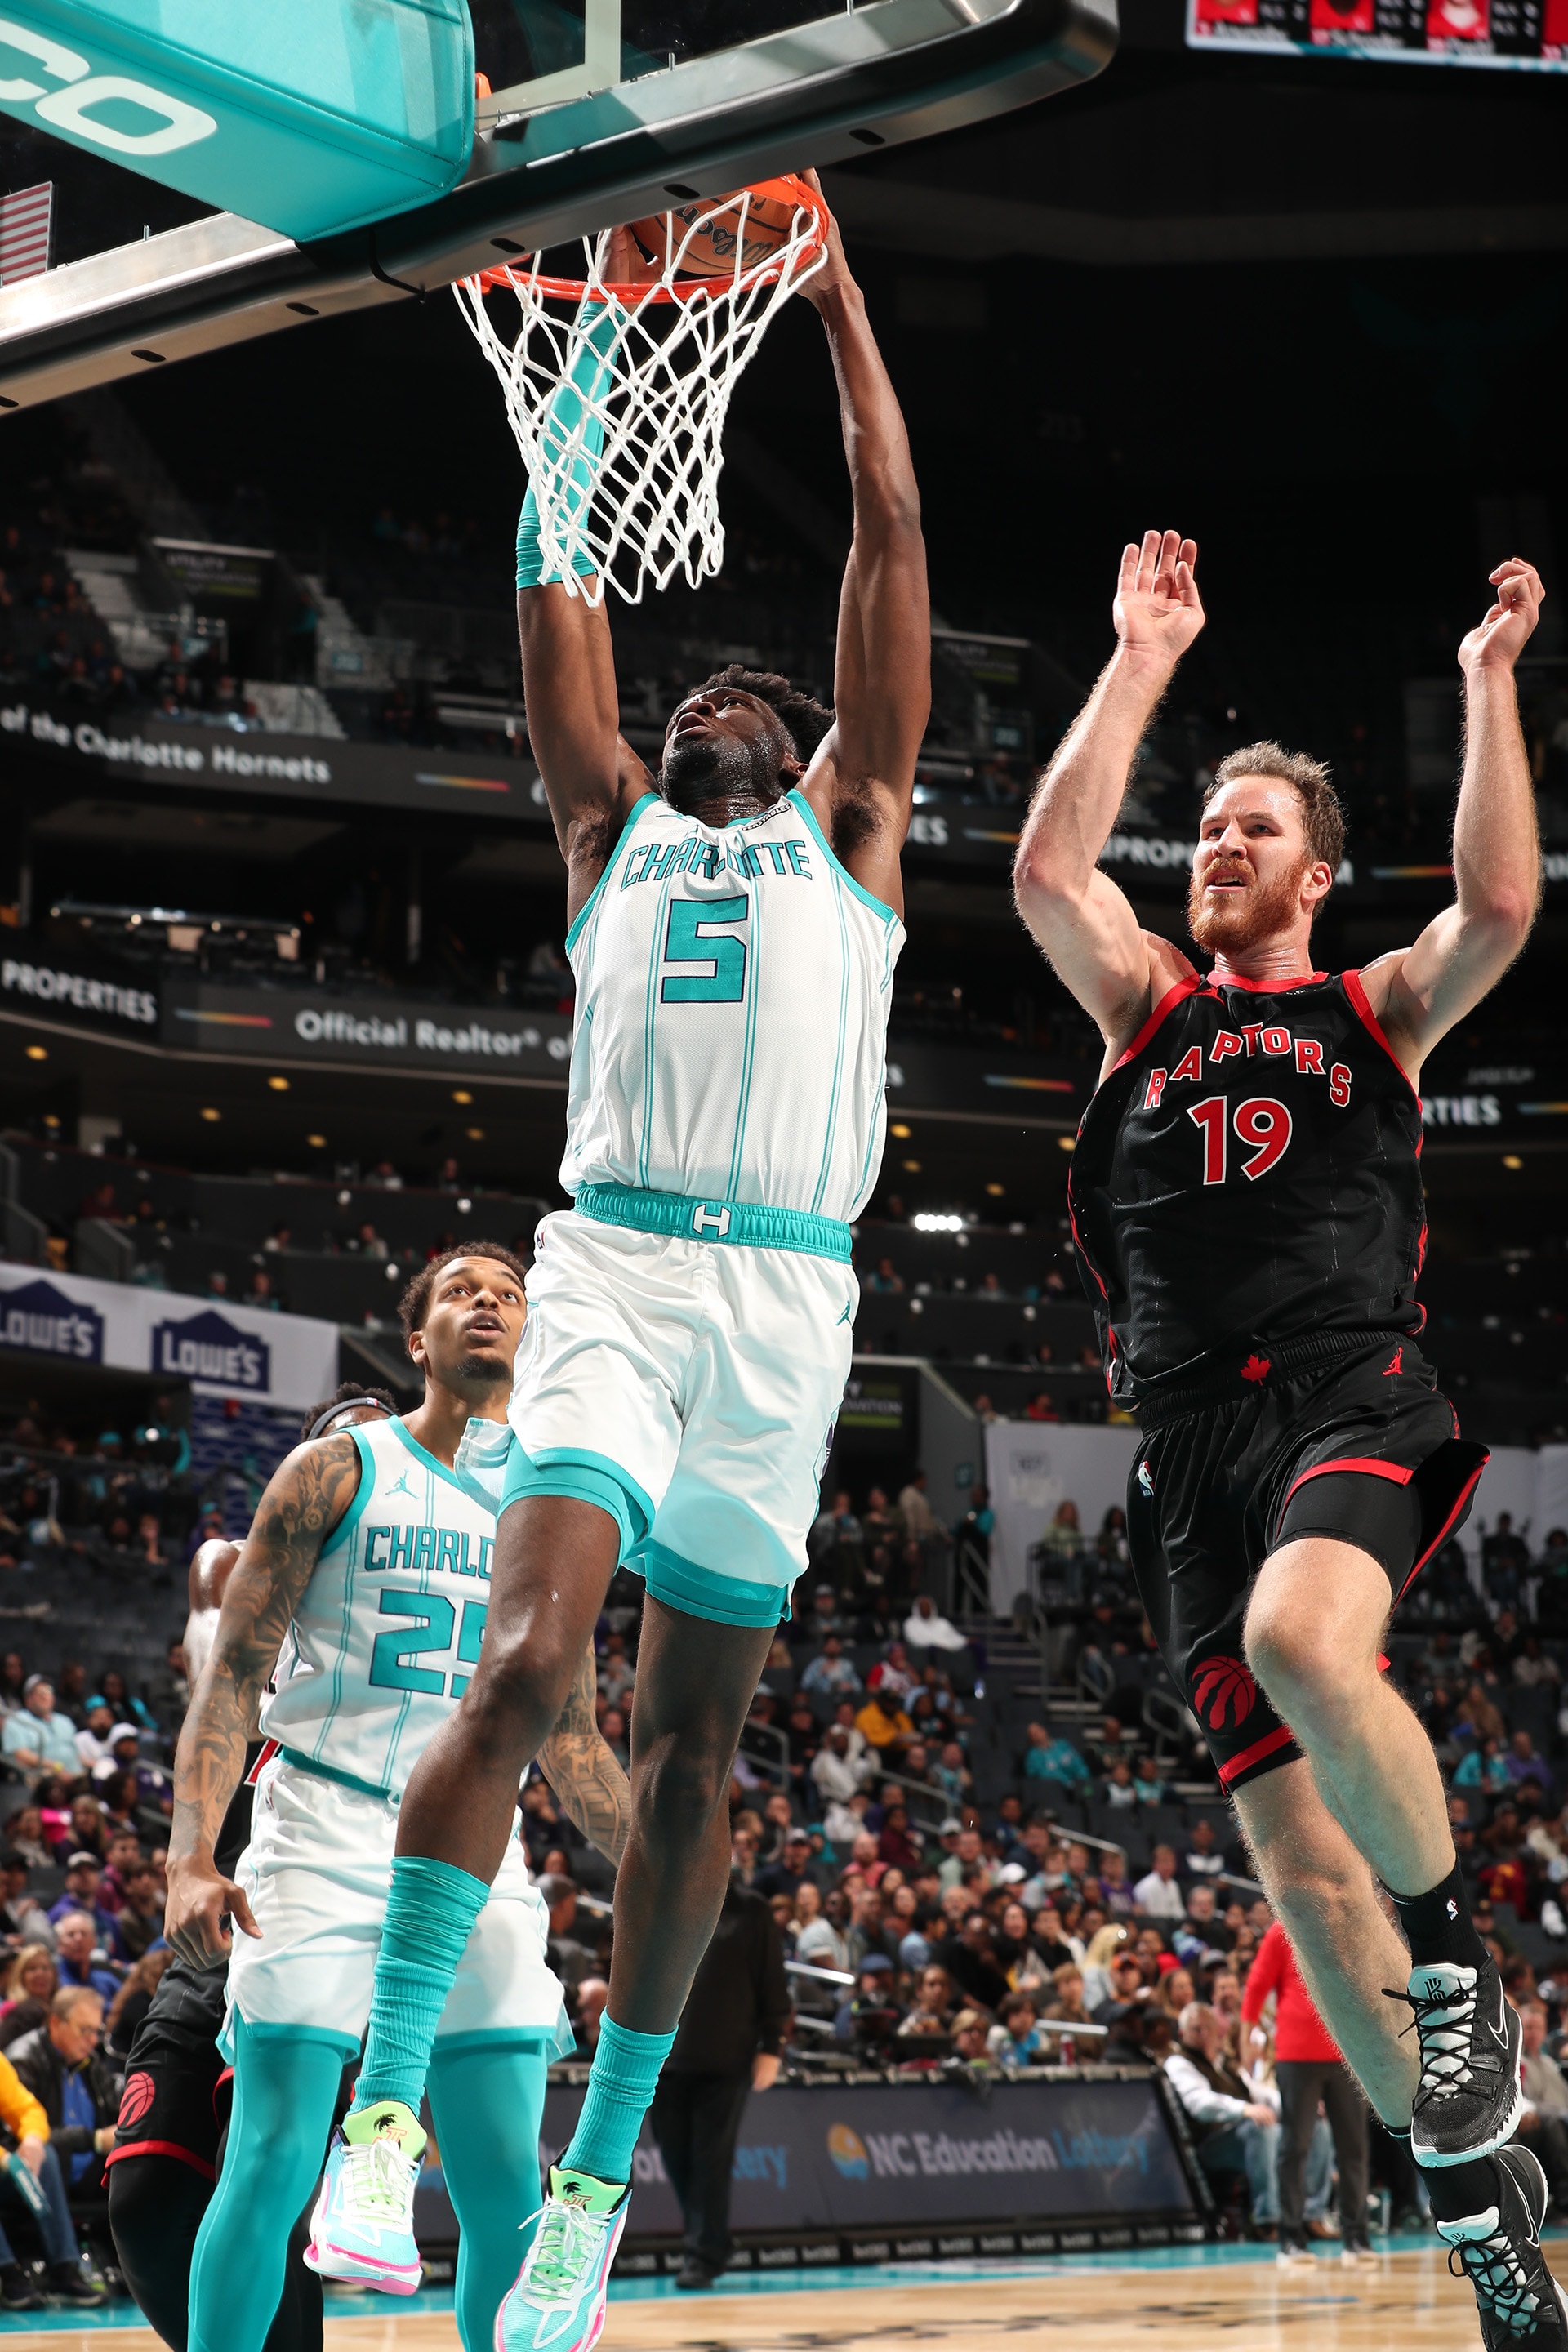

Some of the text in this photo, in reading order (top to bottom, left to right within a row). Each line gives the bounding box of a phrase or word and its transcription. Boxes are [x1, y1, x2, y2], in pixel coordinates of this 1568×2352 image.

[31, 711, 71, 746] the
[74, 723, 204, 771] Charlotte
[212, 744, 331, 784] Hornets
[661, 893, 749, 1003] 5
[2, 959, 157, 1024] PROPERTIES
[295, 1009, 408, 1047] Official
[1143, 1022, 1352, 1110] RAPTORS
[1186, 1095, 1293, 1186] 19
[0, 1308, 97, 1359] OWE'S
[163, 1329, 262, 1386] LOWE'S
[364, 1525, 496, 1580] CHARLO
[369, 1588, 488, 1699] 25
[865, 2131, 916, 2178] NC
[912, 2127, 1060, 2176] Education
